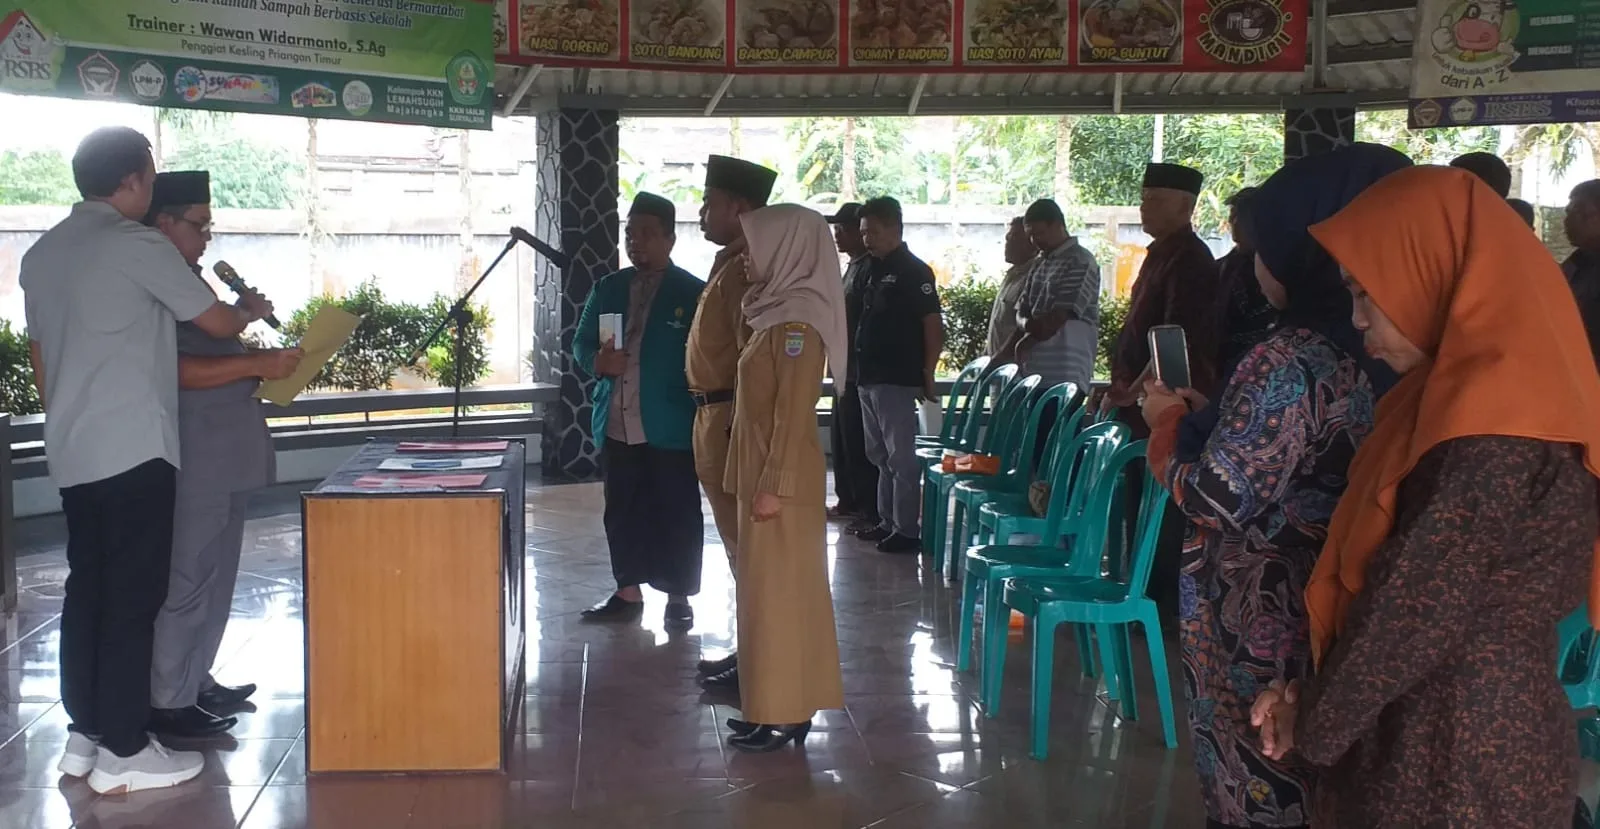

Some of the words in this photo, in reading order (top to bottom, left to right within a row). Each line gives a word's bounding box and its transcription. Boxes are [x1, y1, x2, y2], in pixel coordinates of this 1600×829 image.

[260, 0, 310, 17] Sampah
[314, 3, 365, 22] Berbasis
[369, 11, 411, 28] Sekolah
[396, 0, 464, 17] Bermartabat
[128, 14, 185, 32] Trainer
[200, 22, 254, 41] Wawan
[259, 28, 352, 52] Widarmanto,
[356, 39, 386, 57] S.Ag
[181, 39, 226, 55] Penggiat
[229, 45, 265, 60] Kesling
[268, 48, 311, 64] Priangan
[315, 53, 342, 65] Timur
[530, 37, 558, 50] NASI
[562, 40, 609, 54] GORENG
[634, 44, 664, 56] SOTO
[667, 46, 723, 60] BANDUNG
[969, 47, 995, 60] NASI
[997, 48, 1026, 60] SOTO
[1030, 48, 1063, 60] AYAM
[1091, 48, 1117, 60] SOP
[1120, 47, 1170, 60] BUNTUT
[1197, 31, 1292, 64] MANDIRI
[739, 48, 779, 61] BAKSO
[782, 48, 836, 61] CAMPUR
[854, 48, 895, 61] SIOMAY
[898, 48, 947, 61] BANDUNG
[1440, 73, 1469, 88] dari
[1472, 76, 1485, 89] A
[1495, 68, 1509, 82] Z
[387, 104, 443, 118] Majalengka
